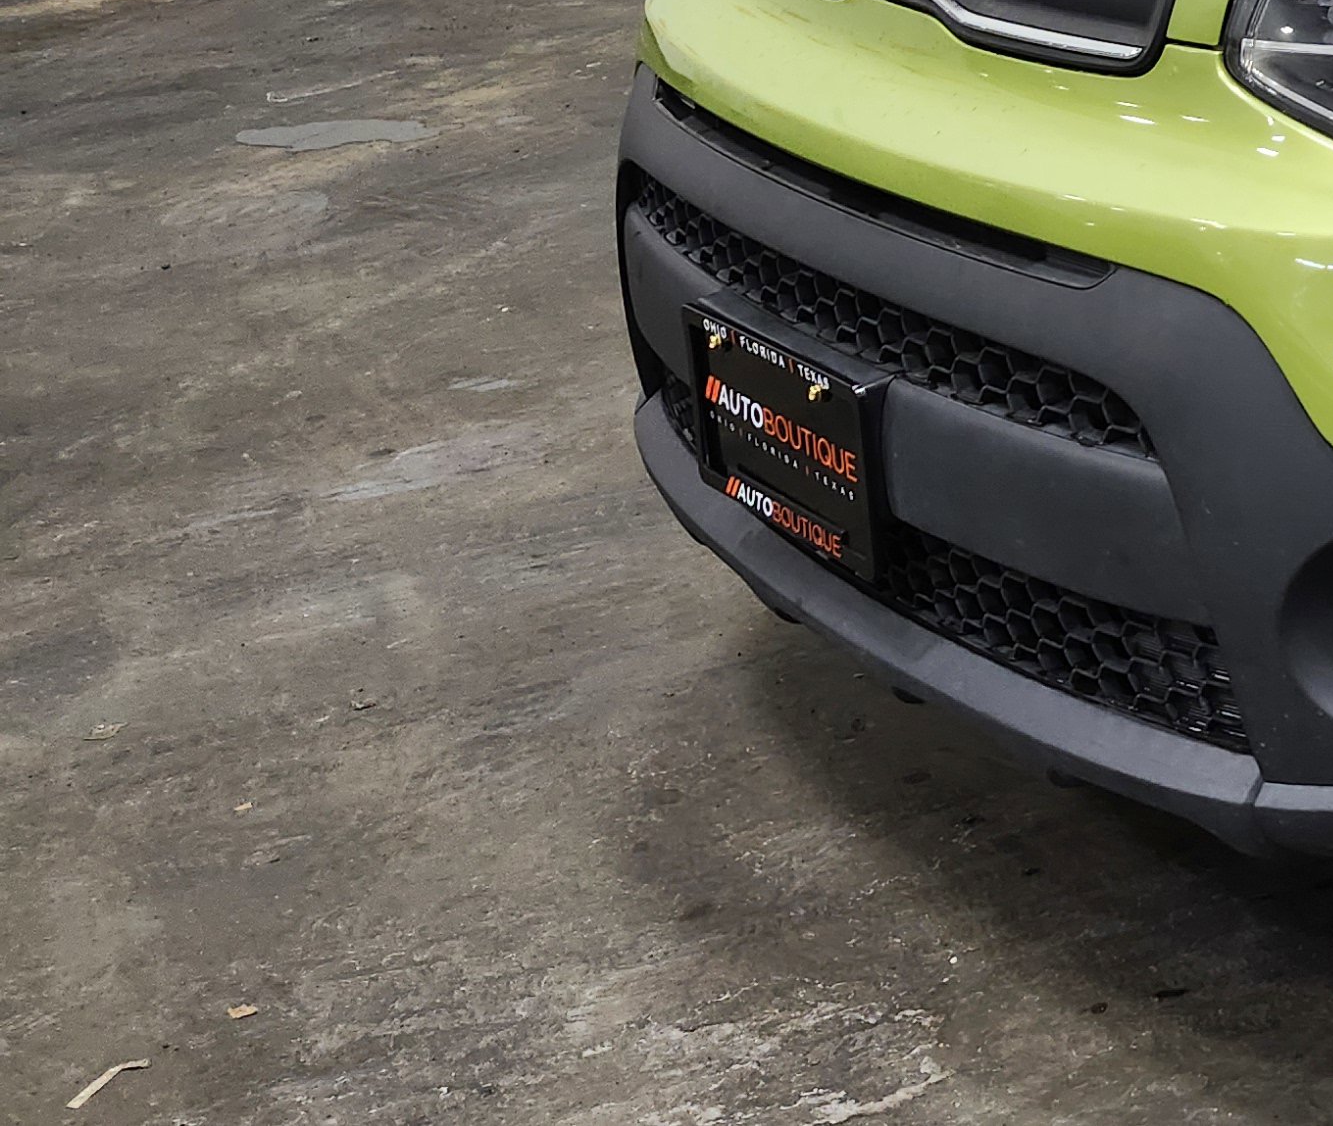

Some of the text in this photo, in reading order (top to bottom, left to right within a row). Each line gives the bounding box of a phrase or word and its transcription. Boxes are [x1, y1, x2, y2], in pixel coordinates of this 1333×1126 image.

[739, 335, 786, 369] FLORIDA
[797, 363, 831, 391] TEXAS
[718, 384, 858, 483] AUTOBOUTIQUE
[736, 482, 842, 559] AUTOBOUTIQUE
